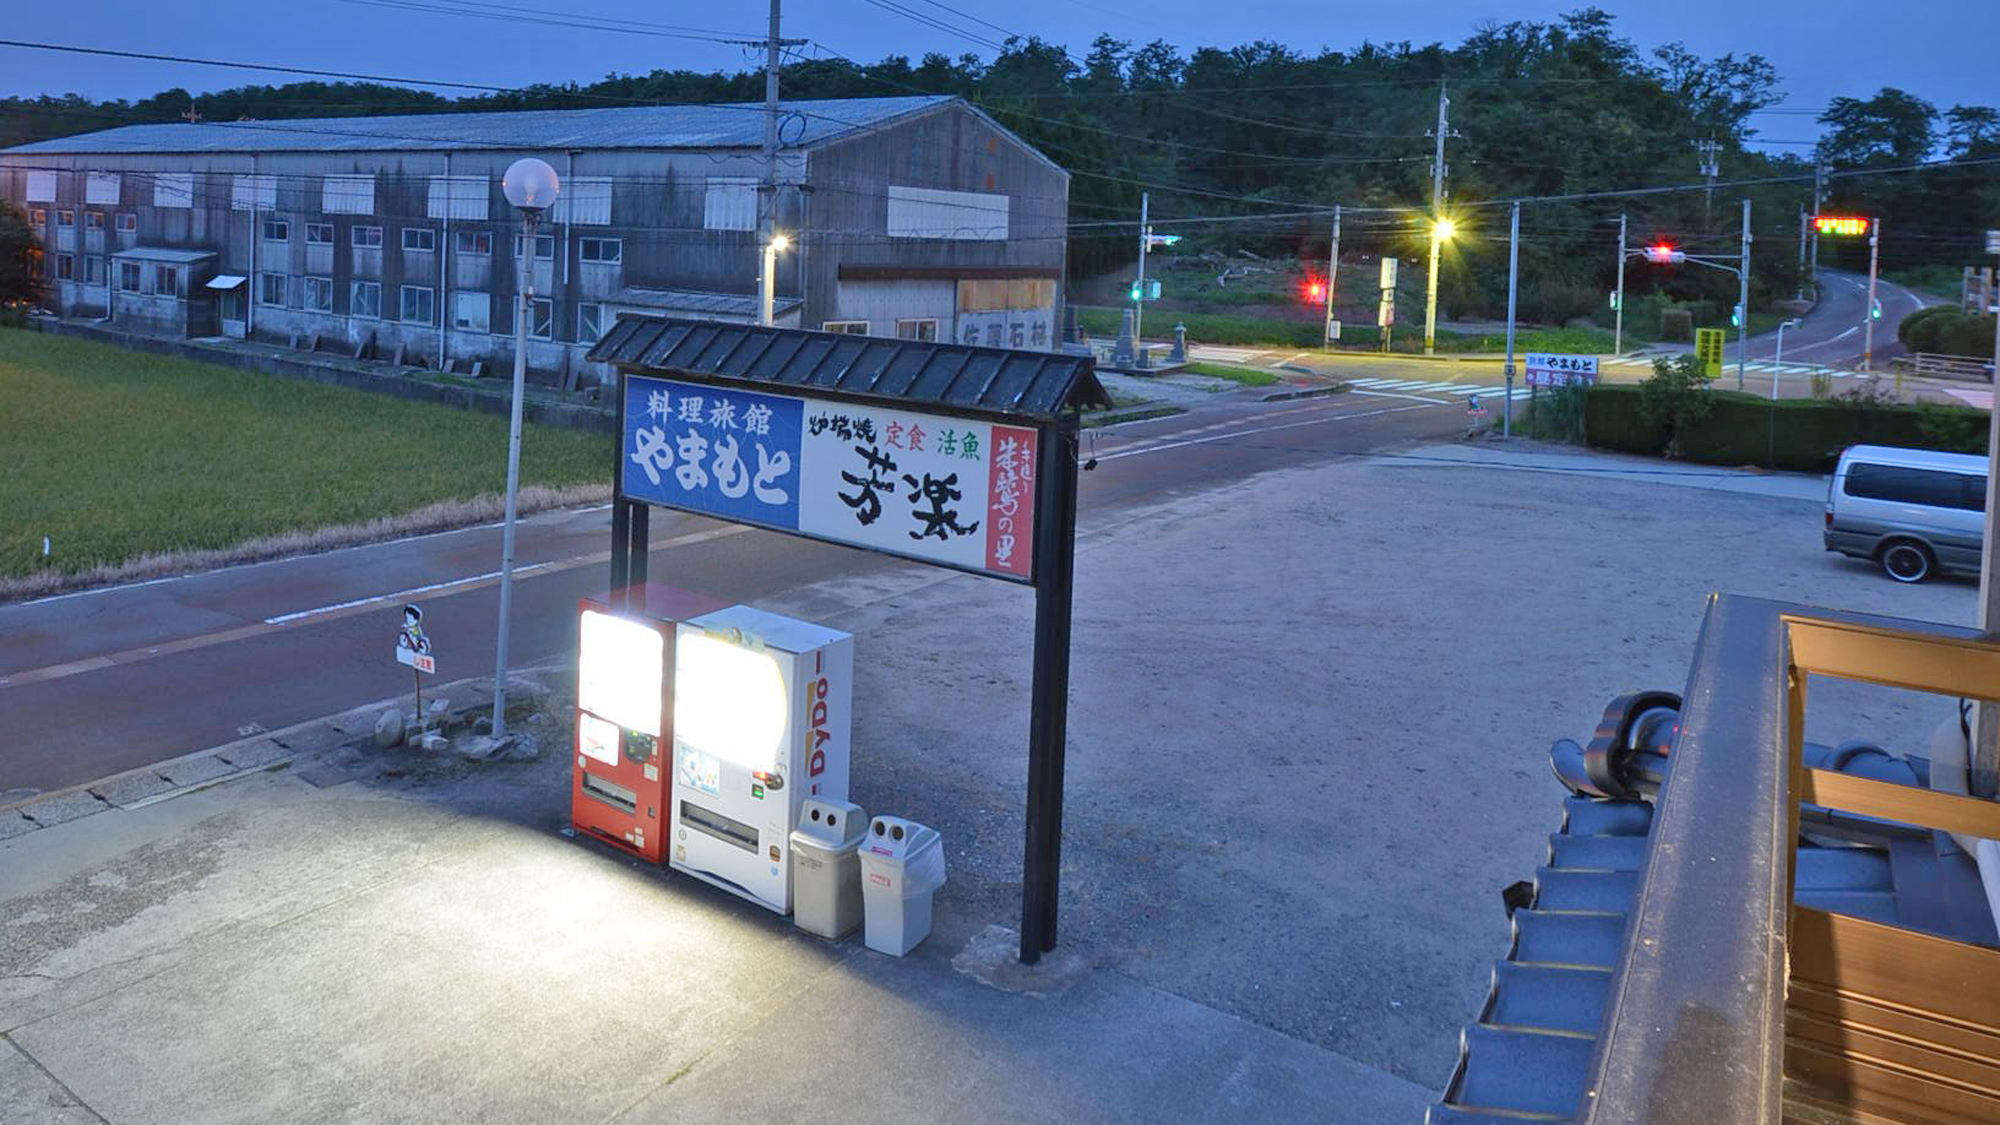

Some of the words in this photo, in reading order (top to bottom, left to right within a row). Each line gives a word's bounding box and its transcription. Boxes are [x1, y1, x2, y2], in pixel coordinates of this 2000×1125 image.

[1547, 356, 1592, 371] やまもと
[646, 389, 773, 436] 料理旅館
[884, 420, 928, 452] 定食
[936, 428, 981, 462] 活魚
[631, 425, 791, 506] やまもと
[838, 445, 980, 542] 芳楽
